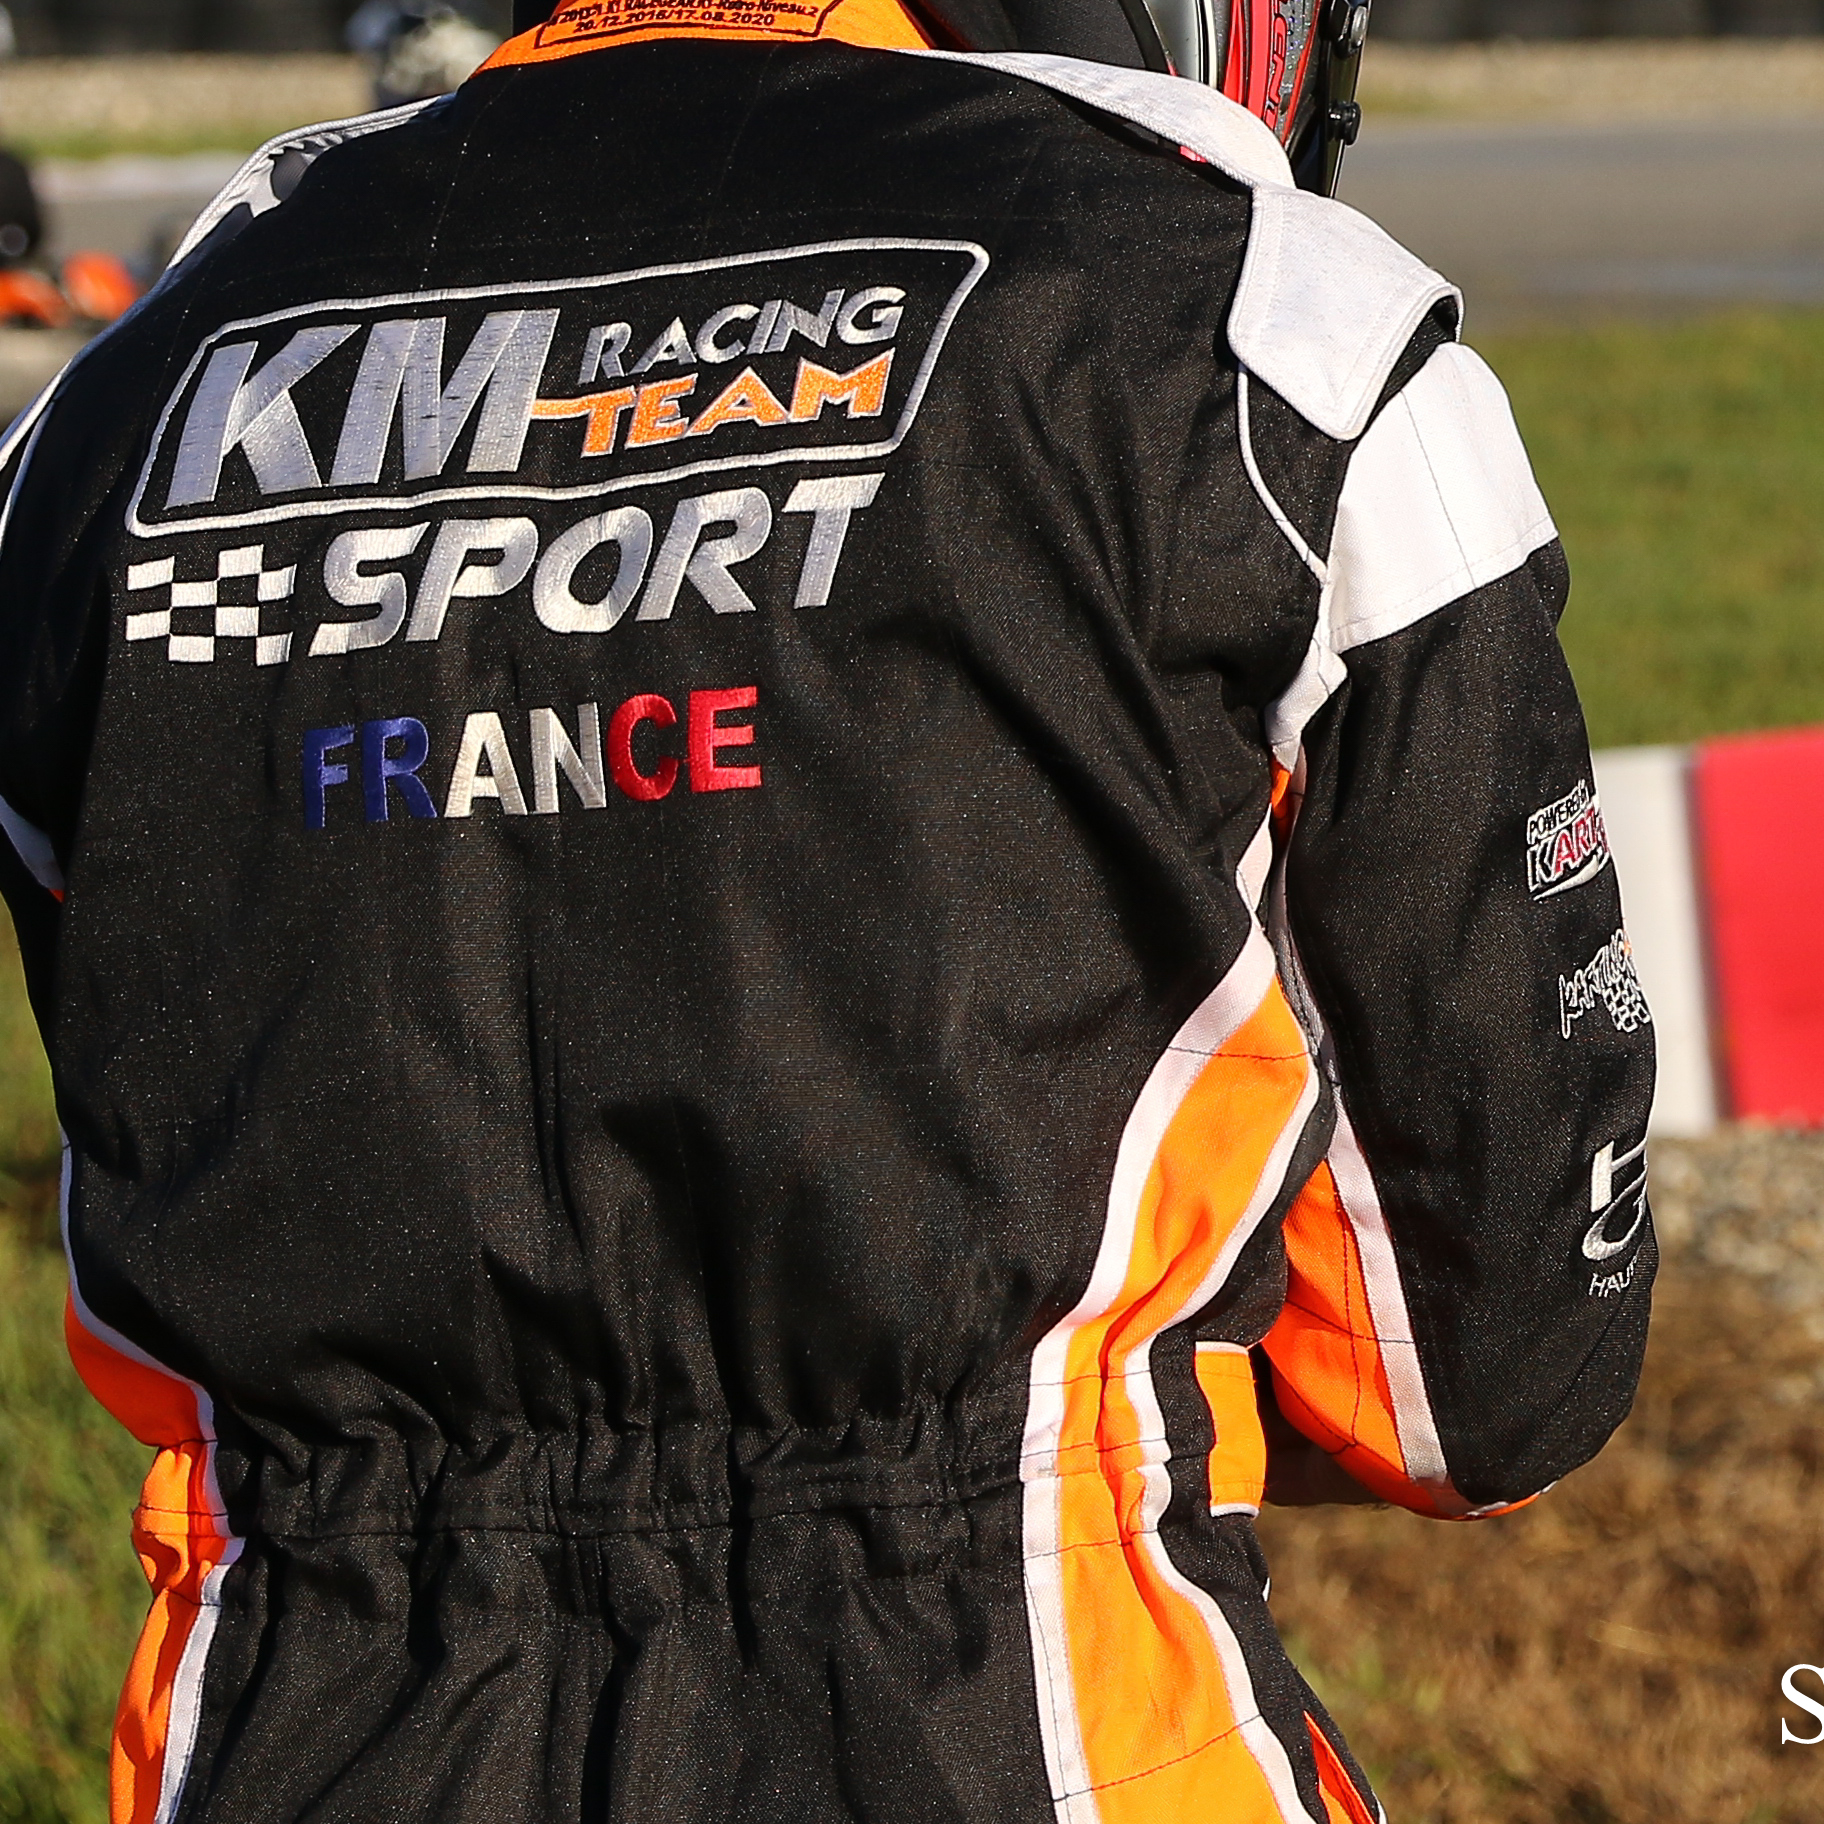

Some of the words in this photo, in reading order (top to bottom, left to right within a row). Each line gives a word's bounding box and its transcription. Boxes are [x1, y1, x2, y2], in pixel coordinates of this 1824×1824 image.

[565, 347, 896, 459] TEAM
[577, 286, 906, 385] RACING
[163, 307, 560, 511] KM
[307, 473, 885, 659] SPORT
[302, 686, 762, 830] FRANCE
